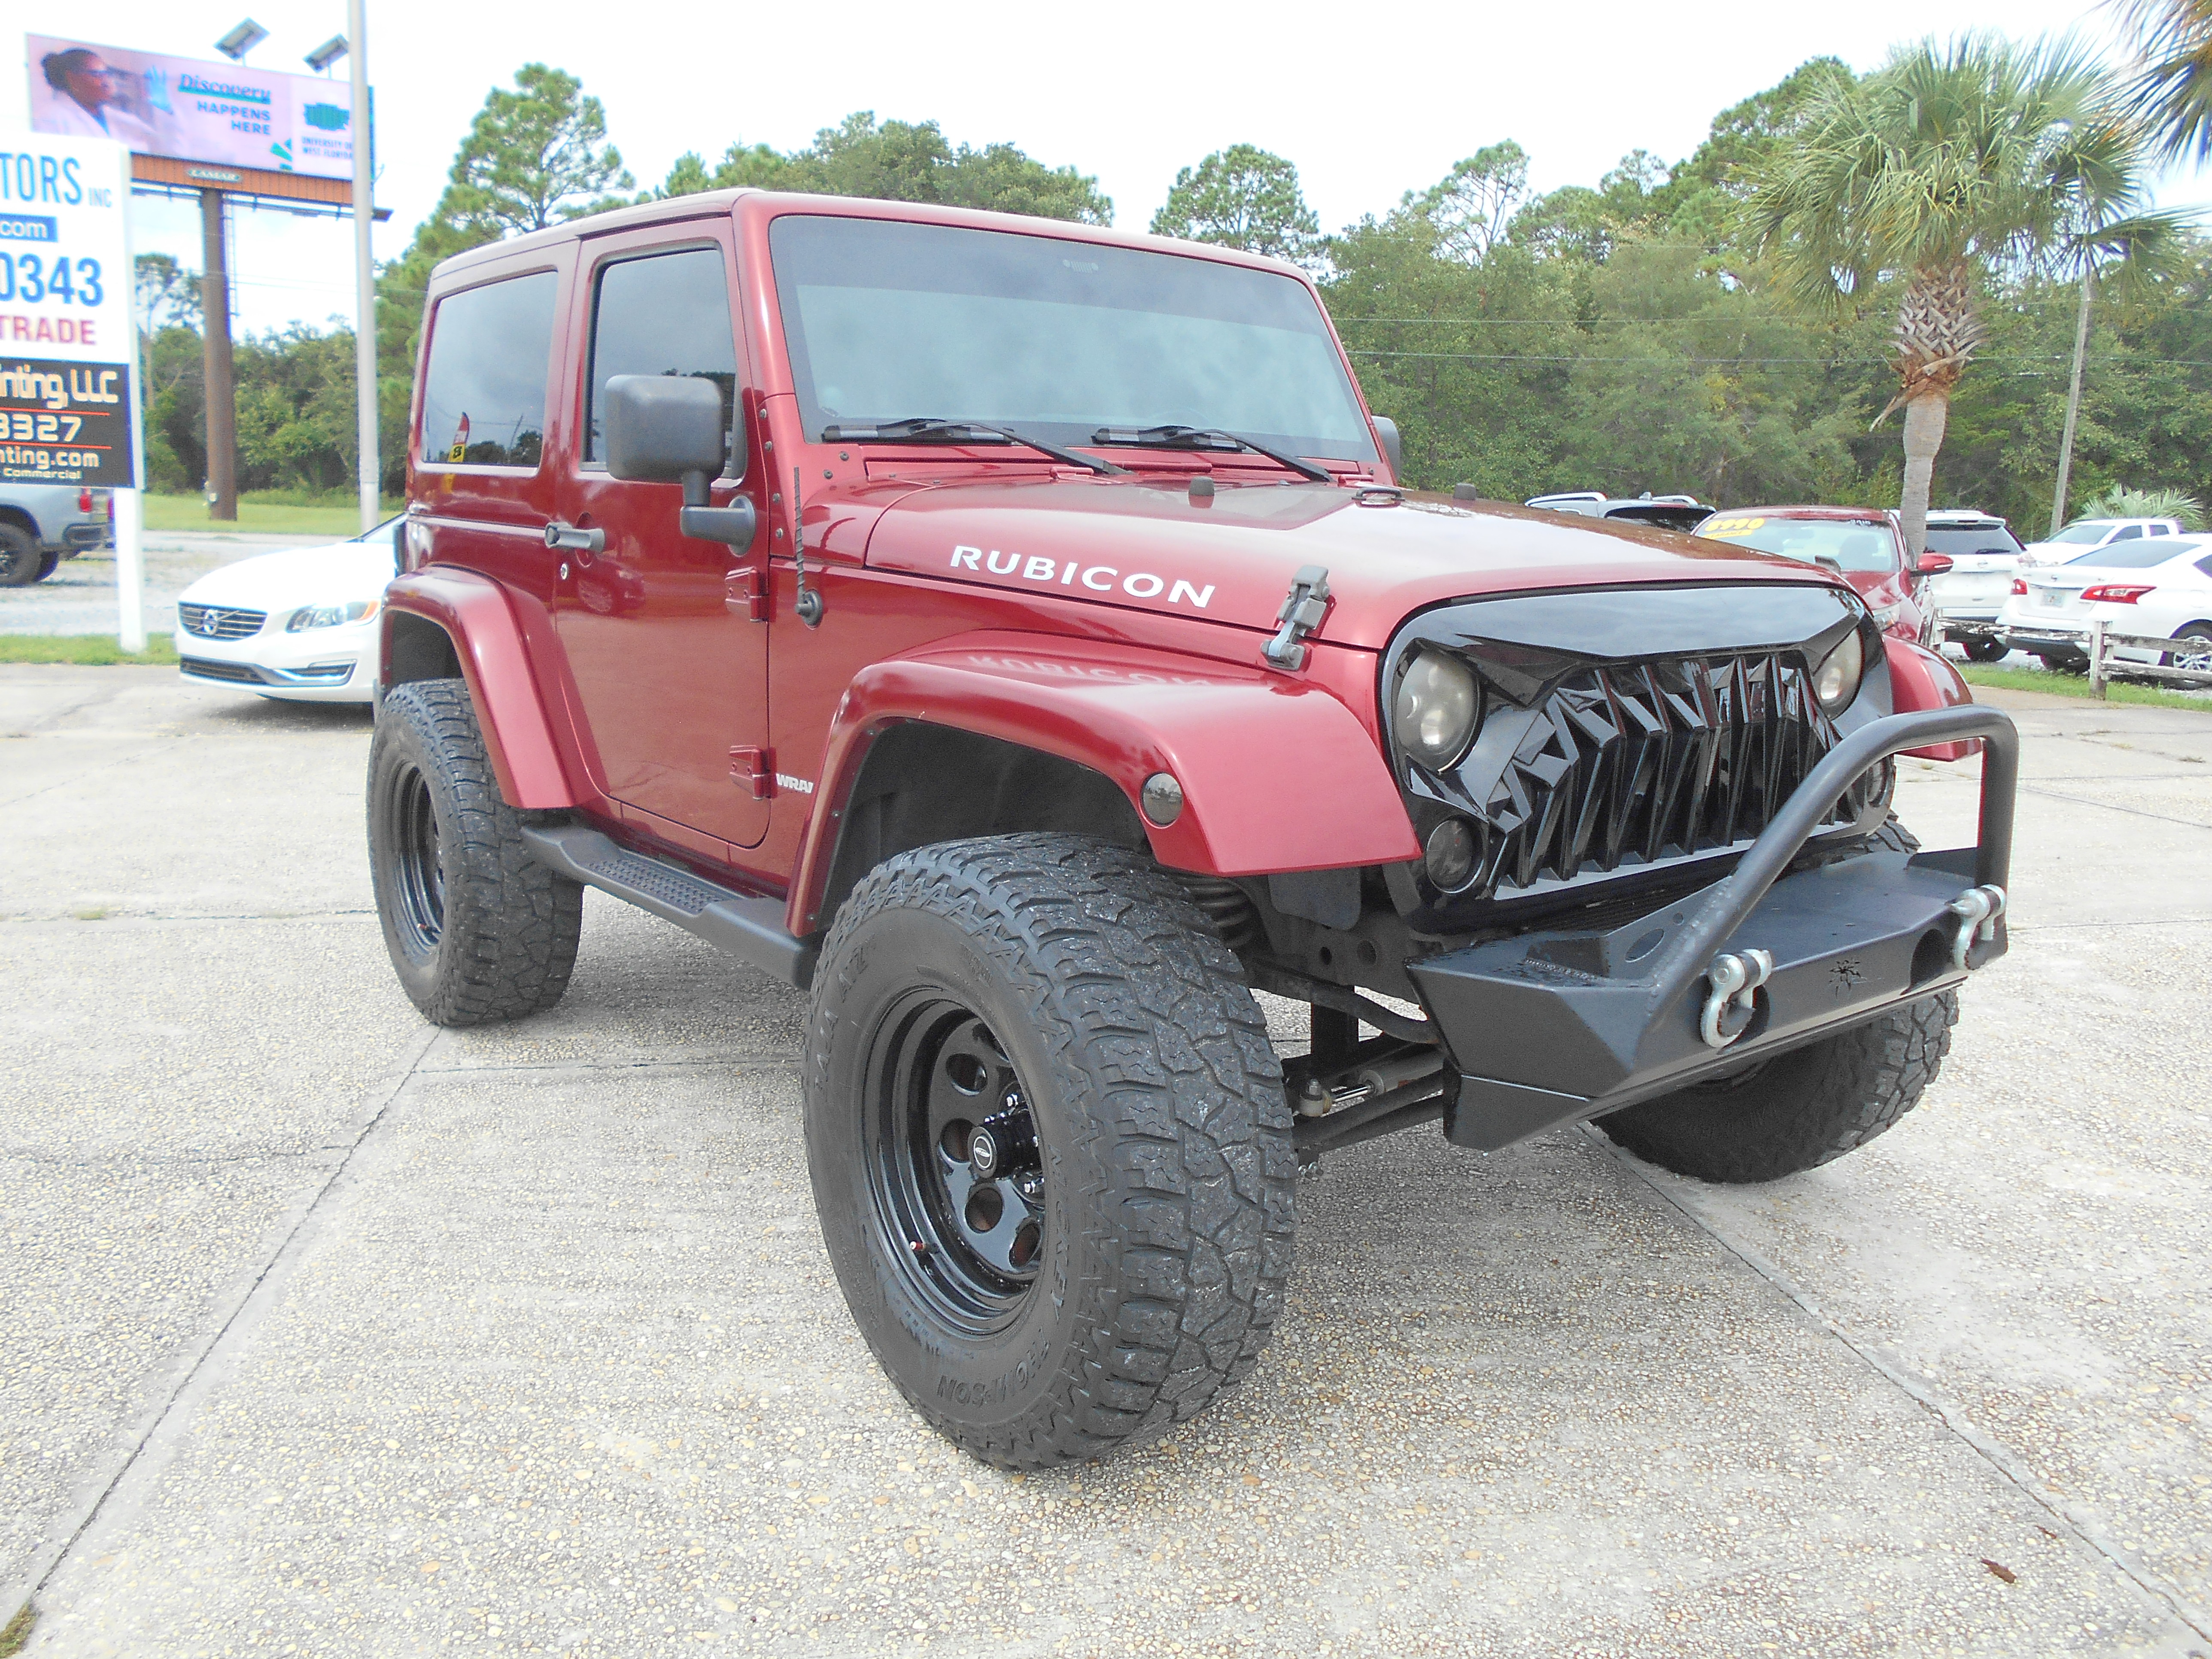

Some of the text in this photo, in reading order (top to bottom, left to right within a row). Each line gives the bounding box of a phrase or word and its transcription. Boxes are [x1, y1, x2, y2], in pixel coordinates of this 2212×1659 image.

[179, 73, 271, 104] Discovery
[197, 100, 270, 121] HAPPENS
[231, 120, 271, 135] HERE
[302, 136, 342, 148] UNIVERSITY
[88, 187, 112, 208] INC
[0, 364, 118, 409] nting LLC
[3, 468, 82, 480] Commercial
[950, 545, 1215, 608] RUBICON
